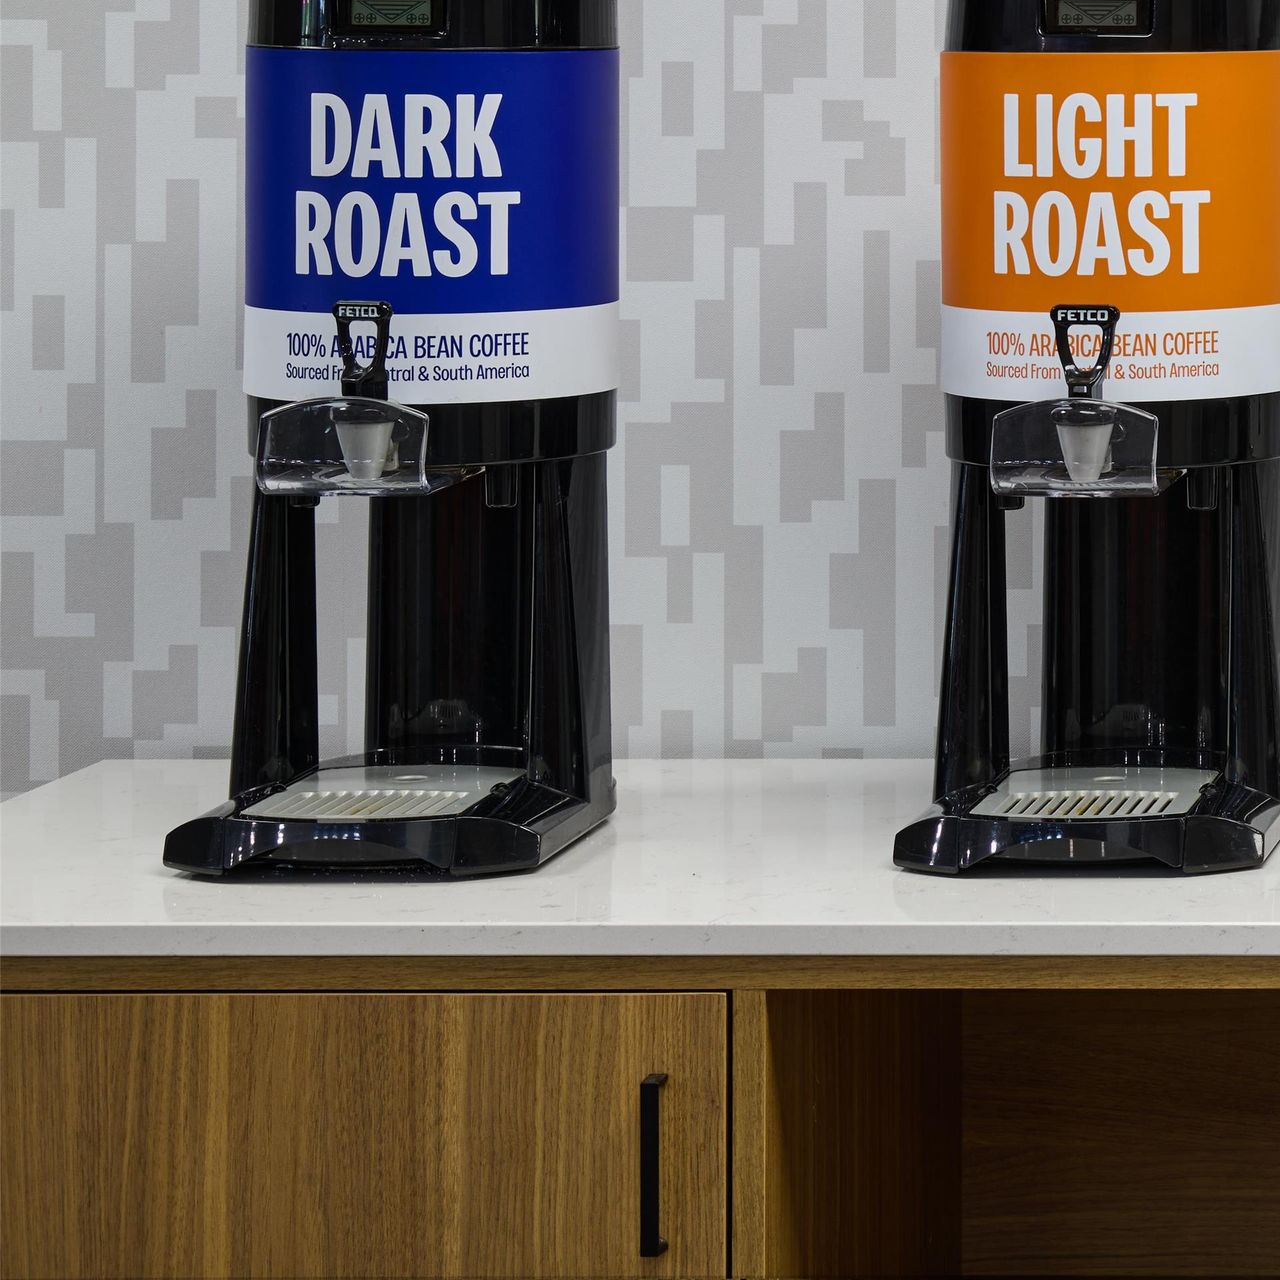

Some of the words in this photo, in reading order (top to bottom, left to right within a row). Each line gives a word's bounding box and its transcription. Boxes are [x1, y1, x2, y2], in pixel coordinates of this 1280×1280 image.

[310, 92, 503, 178] DARK
[1003, 92, 1198, 179] LIGHT
[295, 190, 521, 278] ROAST
[993, 190, 1211, 277] ROAST
[338, 306, 380, 318] FETCO
[1057, 308, 1109, 322] FETCO
[286, 332, 327, 358] 100%
[330, 334, 408, 359] AABCA
[413, 334, 464, 359] BEAN
[469, 332, 530, 358] COFFEE
[986, 331, 1025, 357] 100%
[1163, 331, 1219, 356] COFFEE
[286, 362, 330, 381] Sourced
[417, 365, 430, 382] &
[432, 364, 473, 382] South
[476, 362, 530, 380] America
[986, 361, 1028, 379] Sourced
[1031, 363, 1061, 380] From
[1114, 363, 1126, 380] &
[1128, 362, 1167, 380] South
[1169, 361, 1219, 378] America
